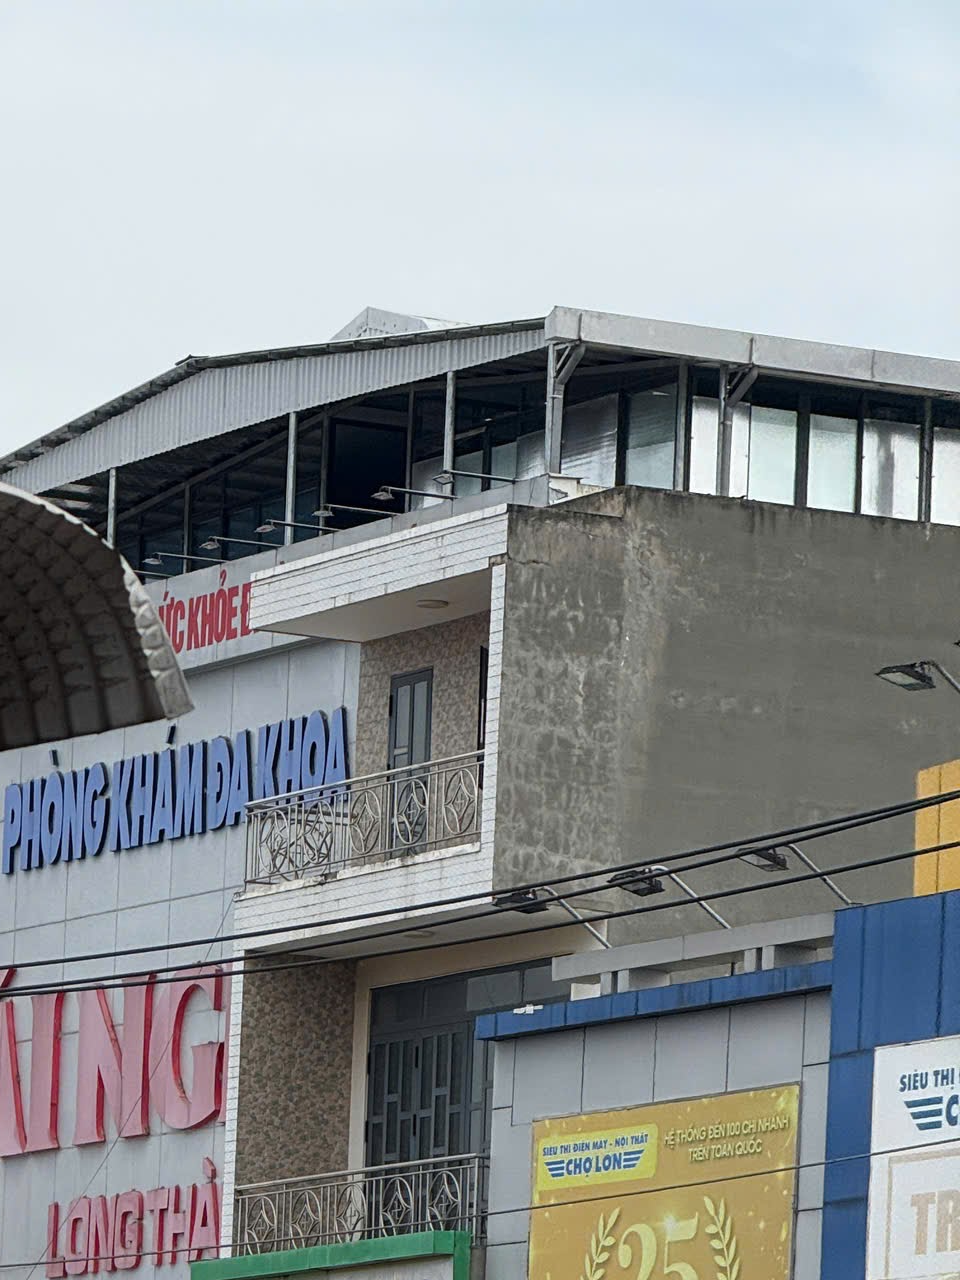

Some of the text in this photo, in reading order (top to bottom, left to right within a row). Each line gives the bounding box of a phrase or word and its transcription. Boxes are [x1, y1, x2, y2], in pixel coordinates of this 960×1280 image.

[187, 569, 240, 651] KHỎE
[1, 705, 352, 875] PHÒNG KHÁM ĐA KHOA
[899, 1068, 955, 1093] SIÊU THỊ
[664, 1114, 790, 1151] HỆ THỐNG ĐẾN 100 CHI NHÁNH
[688, 1135, 763, 1163] TRÊN TOÀN QUỐC
[46, 1157, 224, 1280] LONG THÀ
